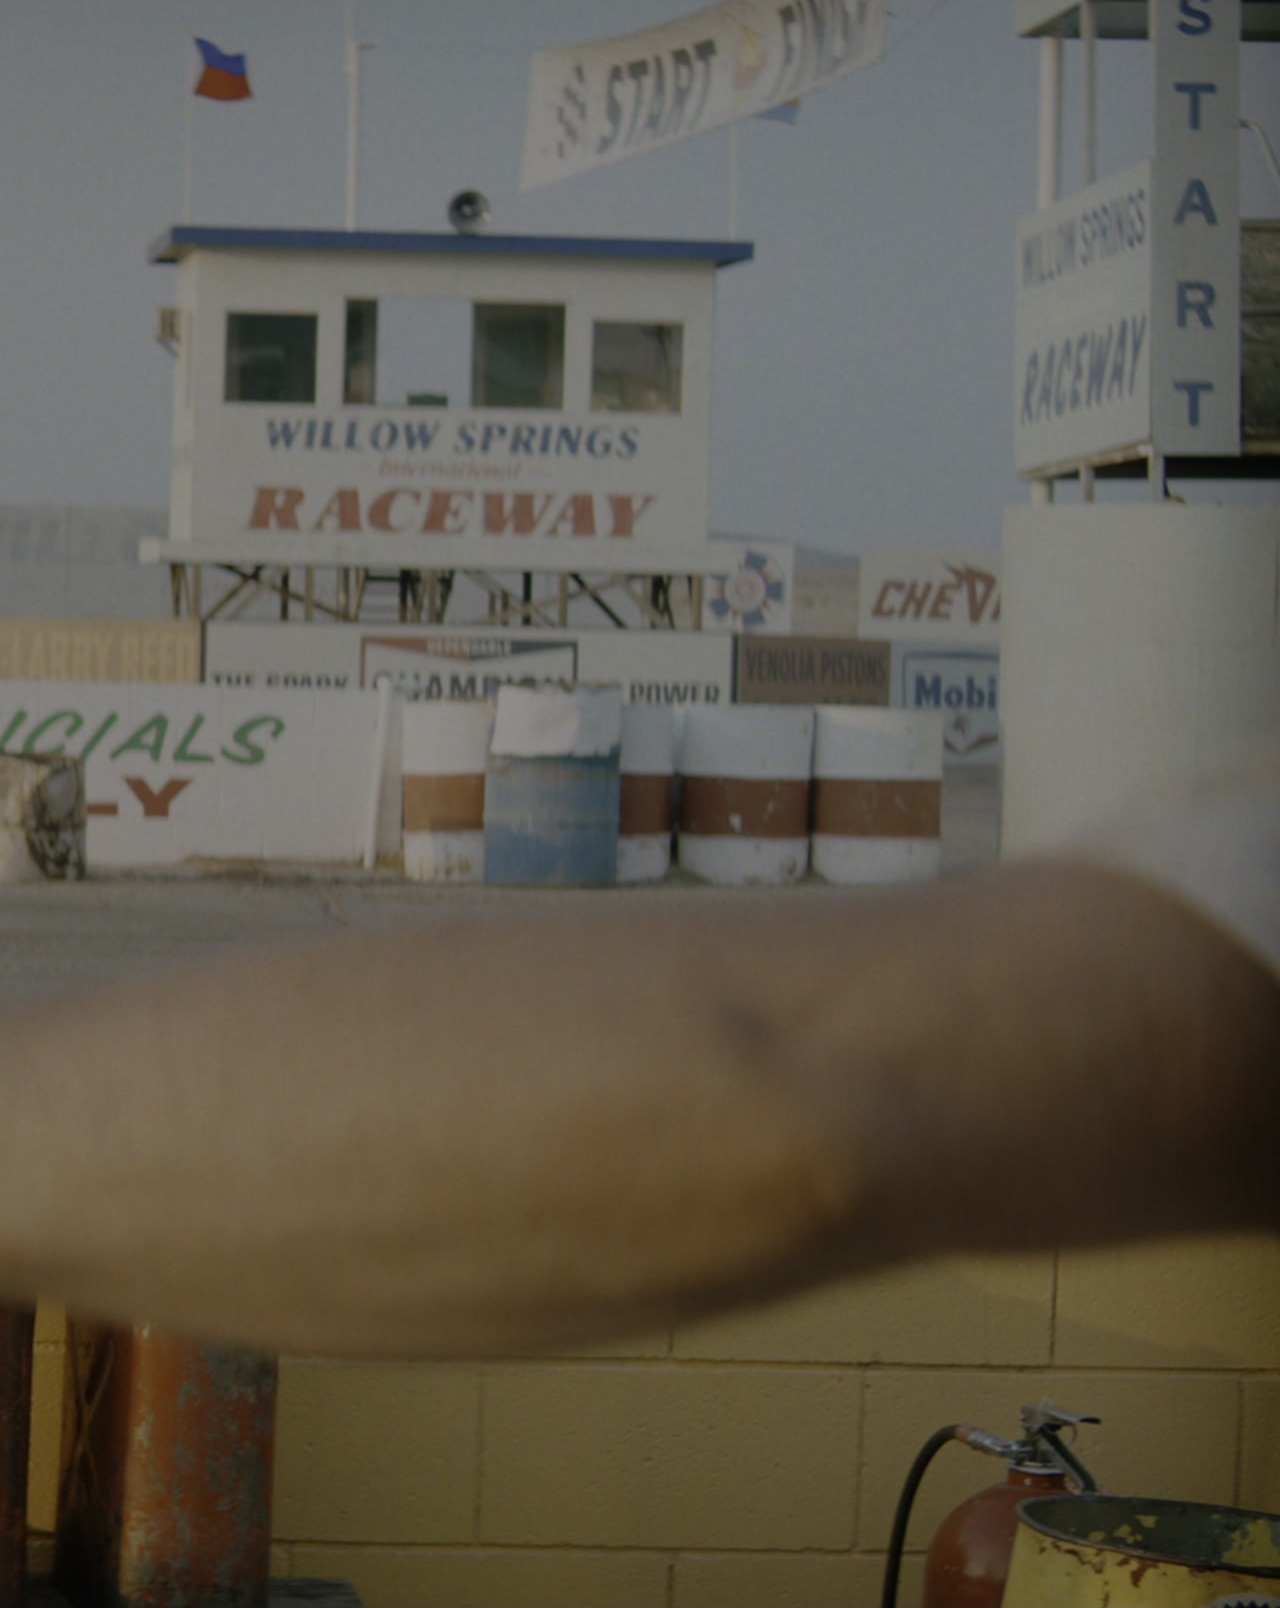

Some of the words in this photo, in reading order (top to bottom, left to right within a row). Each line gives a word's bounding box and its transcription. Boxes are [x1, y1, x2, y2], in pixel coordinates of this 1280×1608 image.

[596, 38, 716, 154] START
[1080, 188, 1146, 266] SPRINGS
[1173, 0, 1218, 427] START
[1020, 312, 1147, 427] RACEWAY
[267, 419, 439, 450] WILLOW
[454, 422, 640, 458] SPRINGS
[248, 485, 657, 538] RACEWAY
[871, 562, 1000, 625] CHEV
[745, 649, 815, 684] VENOLIA
[820, 651, 886, 687] PISTONS
